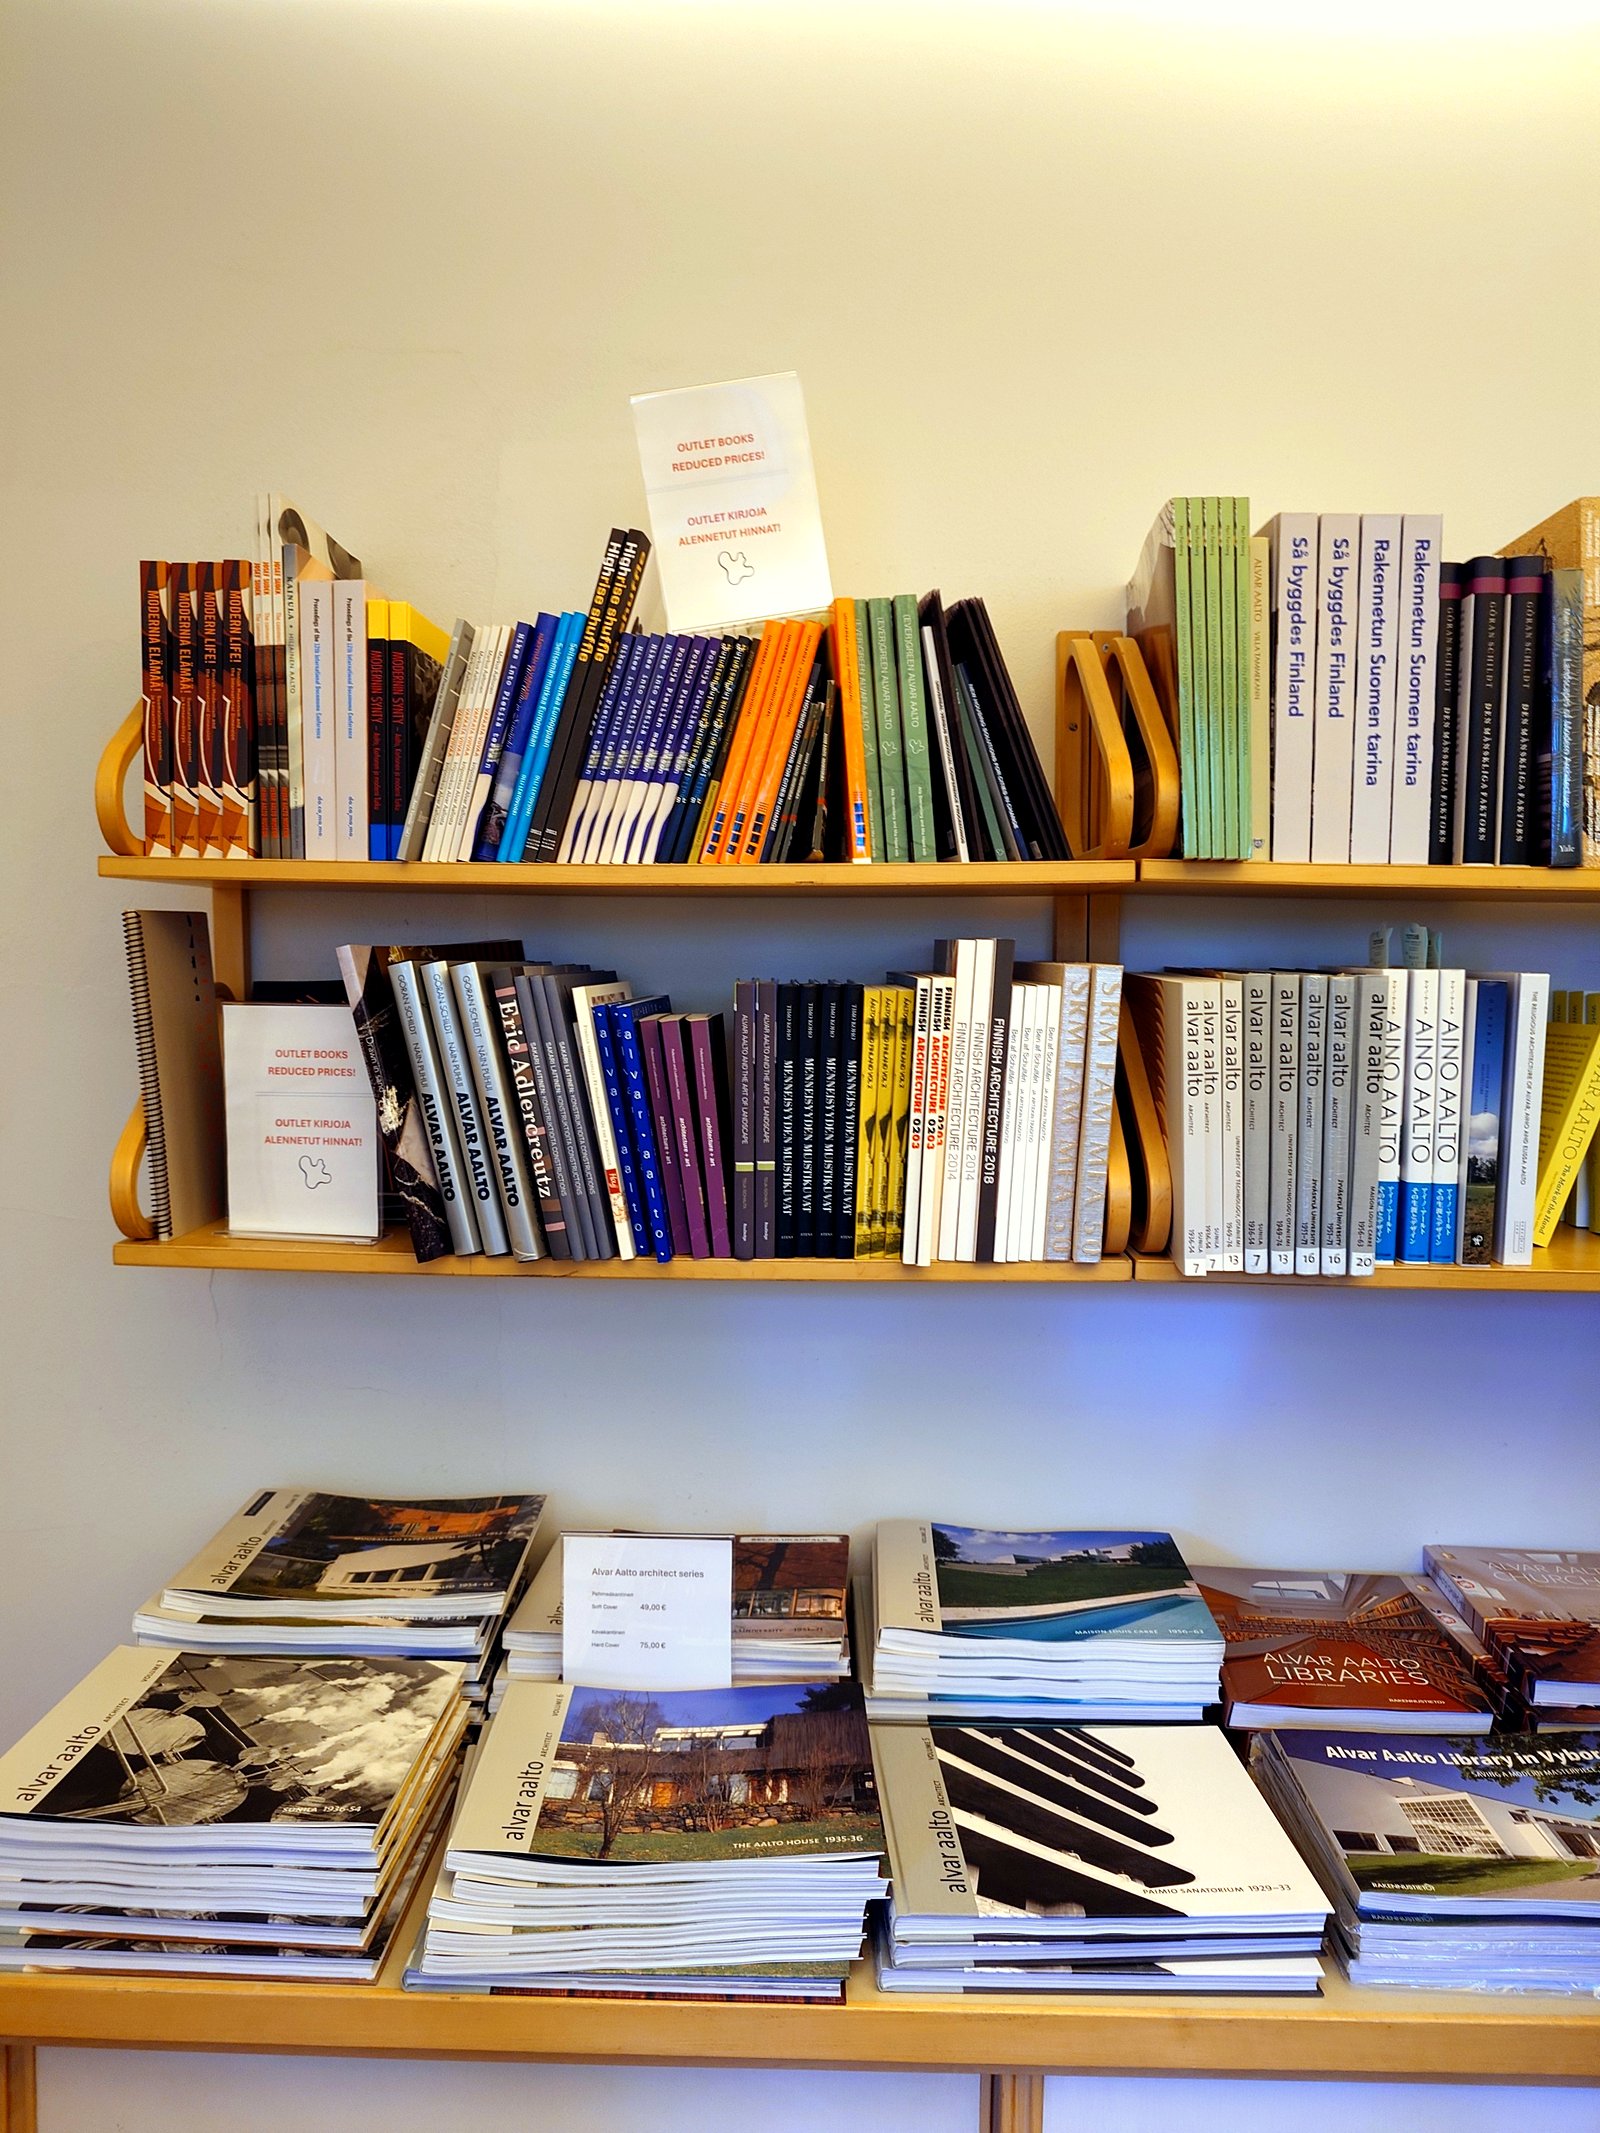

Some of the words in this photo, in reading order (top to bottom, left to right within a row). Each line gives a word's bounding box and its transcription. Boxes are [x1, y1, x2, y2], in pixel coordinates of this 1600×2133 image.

[672, 457, 722, 472] REDUCED
[725, 452, 765, 465] PRICES!
[677, 439, 716, 452] OUTLET
[718, 434, 754, 447] BOOKS
[679, 530, 737, 546] ALENNETUT
[740, 524, 781, 537] HINNAT!
[687, 513, 725, 526] OUTLET
[727, 507, 767, 521] KIRJOJA
[1292, 537, 1308, 560] Så
[1333, 539, 1349, 560] Så
[593, 541, 623, 605] Highrise
[1371, 539, 1389, 648] Rakennetun
[1411, 539, 1430, 648] Rakennetun
[147, 590, 160, 644] MODERNIA
[178, 593, 191, 646] MODERNIA
[204, 592, 216, 635] MODERN
[229, 590, 241, 634] MODERN
[287, 577, 295, 620] KAINULA
[1288, 565, 1308, 645] byggdes
[1328, 565, 1349, 646] byggdes
[205, 639, 217, 664] LIFE!
[230, 637, 242, 662] LIFE!
[511, 633, 526, 660] Hikes
[578, 607, 602, 663] shuffle
[148, 647, 160, 691] ELÄMÄÄ!
[179, 650, 192, 693] ELÄMÄÄ!
[371, 650, 384, 693] MODERNIN
[392, 651, 405, 694] MODERNIN
[506, 664, 517, 686] into
[546, 643, 563, 677] Seitsemän
[539, 679, 553, 705] matkaa
[805, 685, 814, 700] NEW
[883, 681, 892, 708] ALVAR
[1288, 652, 1305, 718] Finland
[1328, 653, 1345, 719] Finland
[1368, 655, 1385, 727] Suomen
[1407, 655, 1425, 727] Suomen
[371, 696, 384, 724] SYNTY
[392, 698, 405, 725] SYNTY
[529, 705, 547, 747] Eurooppaan
[798, 700, 809, 728] HOUSING
[884, 709, 893, 730] AALTO
[788, 729, 802, 764] SOLUTIONS
[1365, 733, 1382, 786] tarina
[1405, 734, 1421, 786] tarina
[779, 778, 789, 797] CITIES
[784, 764, 793, 778] FOR
[770, 805, 782, 832] CHANGE
[918, 987, 928, 1032] FINNISH
[1187, 1002, 1203, 1045] alvar
[1225, 999, 1241, 1043] alvar
[1250, 988, 1268, 1036] alvar
[1308, 994, 1325, 1038] alvar
[1369, 993, 1388, 1041] alvar
[275, 1050, 312, 1059] OUTLET
[314, 1050, 348, 1059] BOOKS
[973, 1022, 984, 1066] FINNISH
[992, 1018, 1006, 1062] FINNISH
[1414, 1019, 1435, 1081] AINO
[1440, 1019, 1460, 1081] AINO
[268, 1067, 315, 1076] REDUCED
[318, 1067, 356, 1077] PRICES!
[913, 1037, 926, 1114] ARCHITECTURE
[1187, 1050, 1203, 1096] aalto
[1225, 1048, 1242, 1091] aalto
[1250, 1042, 1267, 1091] aalto
[1307, 1043, 1323, 1087] aalto
[1367, 1046, 1384, 1094] aalto
[403, 1004, 417, 1036] SCHILDT
[421, 1093, 443, 1146] ALVAR
[434, 1148, 456, 1202] AALTO
[499, 999, 520, 1052] Eric
[510, 1059, 550, 1199] Adlercreutz
[966, 1068, 982, 1151] ARCHITECTURE
[984, 1063, 1003, 1153] ARCHITECTURE
[265, 1136, 321, 1145] ALENNETUT
[323, 1137, 362, 1146] HINNAT!
[275, 1119, 312, 1128] OUTLET
[314, 1120, 351, 1129] KIRJOJA
[911, 1118, 921, 1150] 0203
[1411, 1087, 1432, 1164] AALTO
[1437, 1087, 1458, 1164] AALTO
[1563, 1100, 1595, 1160] AALTO
[456, 1092, 477, 1145] ALVAR
[468, 1147, 490, 1201] AALTO
[485, 1096, 506, 1149] ALVAR
[497, 1151, 519, 1207] AALTO
[965, 1154, 976, 1181] 2014
[983, 1155, 995, 1184] 2018
[1554, 1177, 1566, 1196] Mark
[1562, 1164, 1572, 1176] The
[1539, 1214, 1551, 1235] Hand
[1547, 1205, 1555, 1215] the
[1193, 1263, 1199, 1274] 7
[1228, 1255, 1239, 1265] 13
[1303, 1253, 1315, 1264] 16
[1357, 1258, 1372, 1267] 20
[211, 1558, 242, 1585] alvar
[235, 1535, 262, 1568] aalto
[592, 1568, 613, 1576] Alvar
[615, 1568, 637, 1577] Aalto
[640, 1569, 677, 1578] architect
[679, 1570, 704, 1578] series
[913, 1571, 931, 1596] aalto
[920, 1596, 934, 1623] alvar
[1264, 1652, 1335, 1666] ALVAR
[1344, 1657, 1419, 1669] AALTO
[1267, 1665, 1429, 1686] LIBRARIES
[17, 1758, 64, 1803] alvar
[57, 1724, 101, 1763] aalto
[1325, 1745, 1377, 1760] Alvar
[1382, 1749, 1437, 1765] Aalto
[1443, 1752, 1514, 1768] Library
[1515, 1753, 1539, 1765] in
[282, 1806, 318, 1814] SUNILA
[322, 1805, 362, 1814] 1936-54
[501, 1796, 533, 1841] alvar
[517, 1760, 545, 1800] aalto
[733, 1841, 751, 1849] THE
[754, 1839, 784, 1848] AALTO
[786, 1837, 820, 1846] HOUSE
[824, 1834, 863, 1844] 1935-36
[927, 1809, 954, 1852] aalto
[939, 1851, 968, 1894] alvar
[1142, 1886, 1177, 1895] PAIMIO
[1180, 1886, 1245, 1894] SANATORIUM
